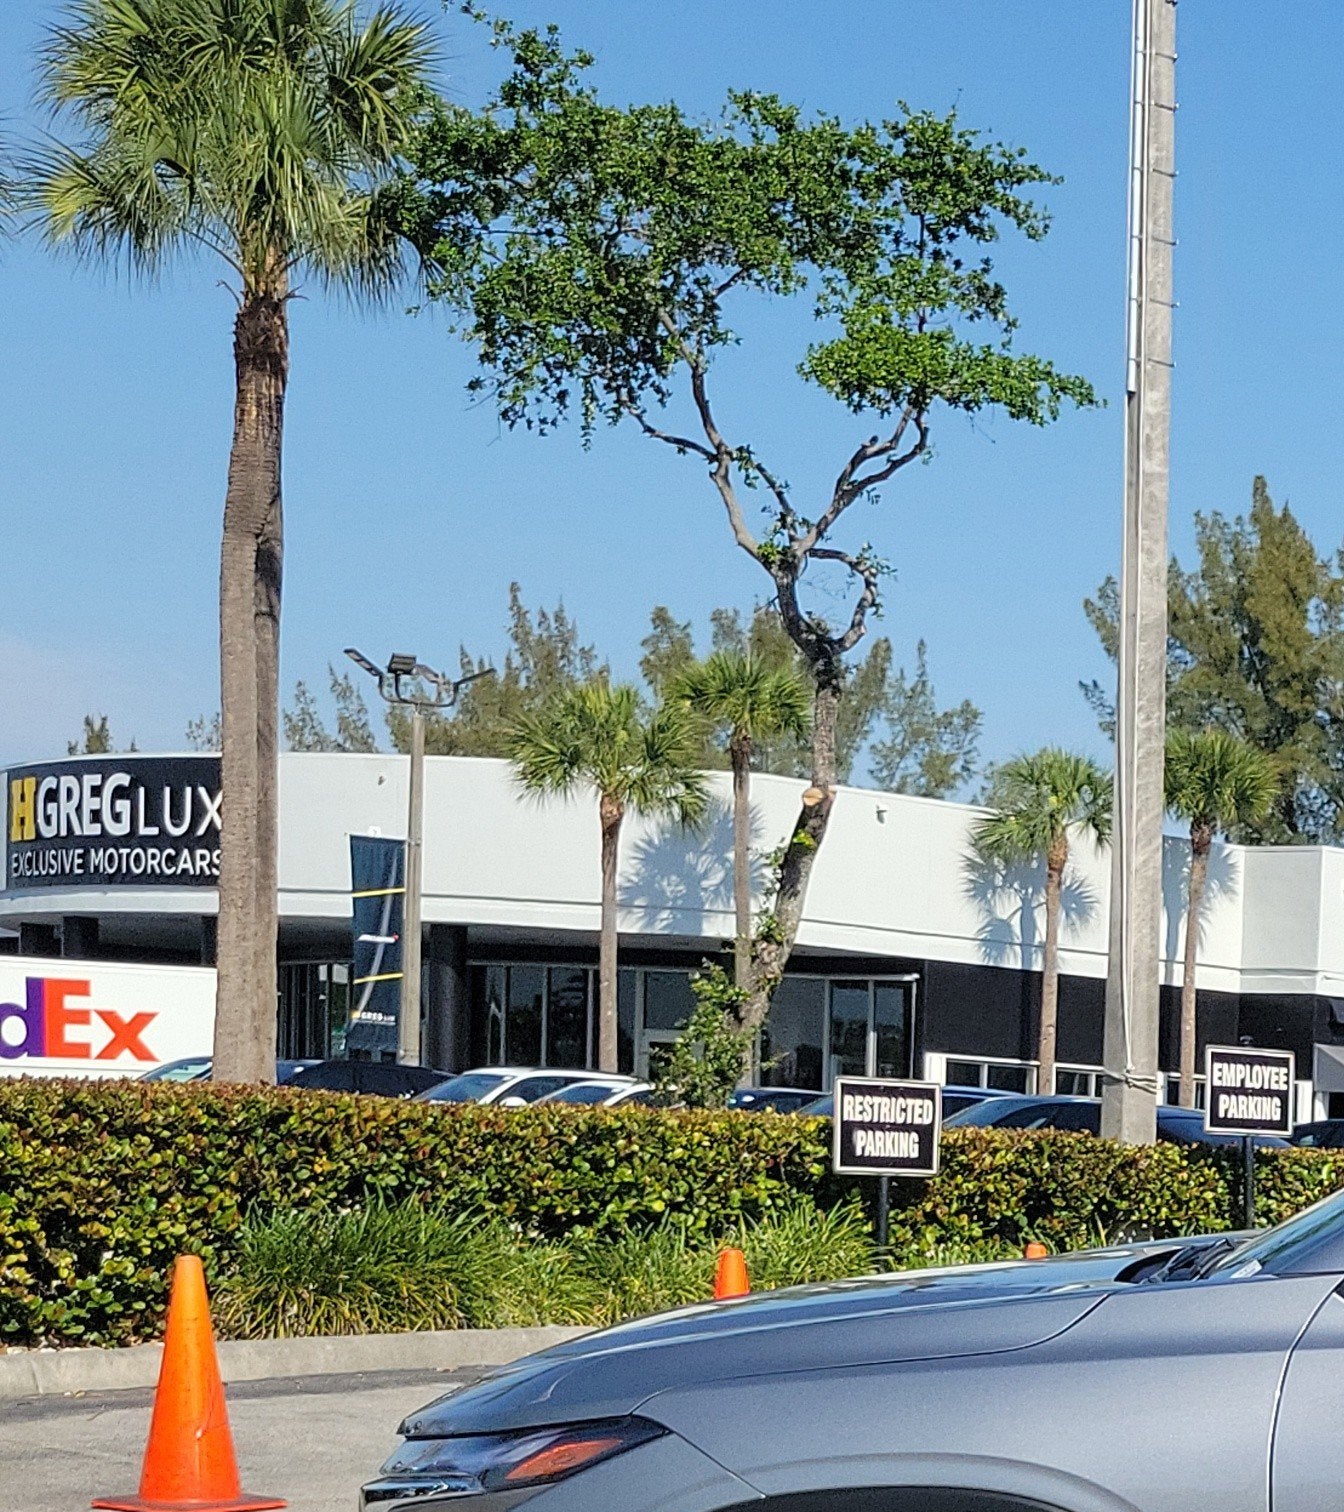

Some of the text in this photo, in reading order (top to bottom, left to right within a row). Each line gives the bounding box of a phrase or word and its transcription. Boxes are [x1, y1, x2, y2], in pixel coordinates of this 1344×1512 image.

[12, 848, 84, 877] EXCLUSIVE
[1212, 1062, 1288, 1090] EMPLOYEE
[843, 1094, 933, 1125] RESTRICTED
[1218, 1094, 1281, 1121] PARKING
[854, 1129, 919, 1158] PARKING
